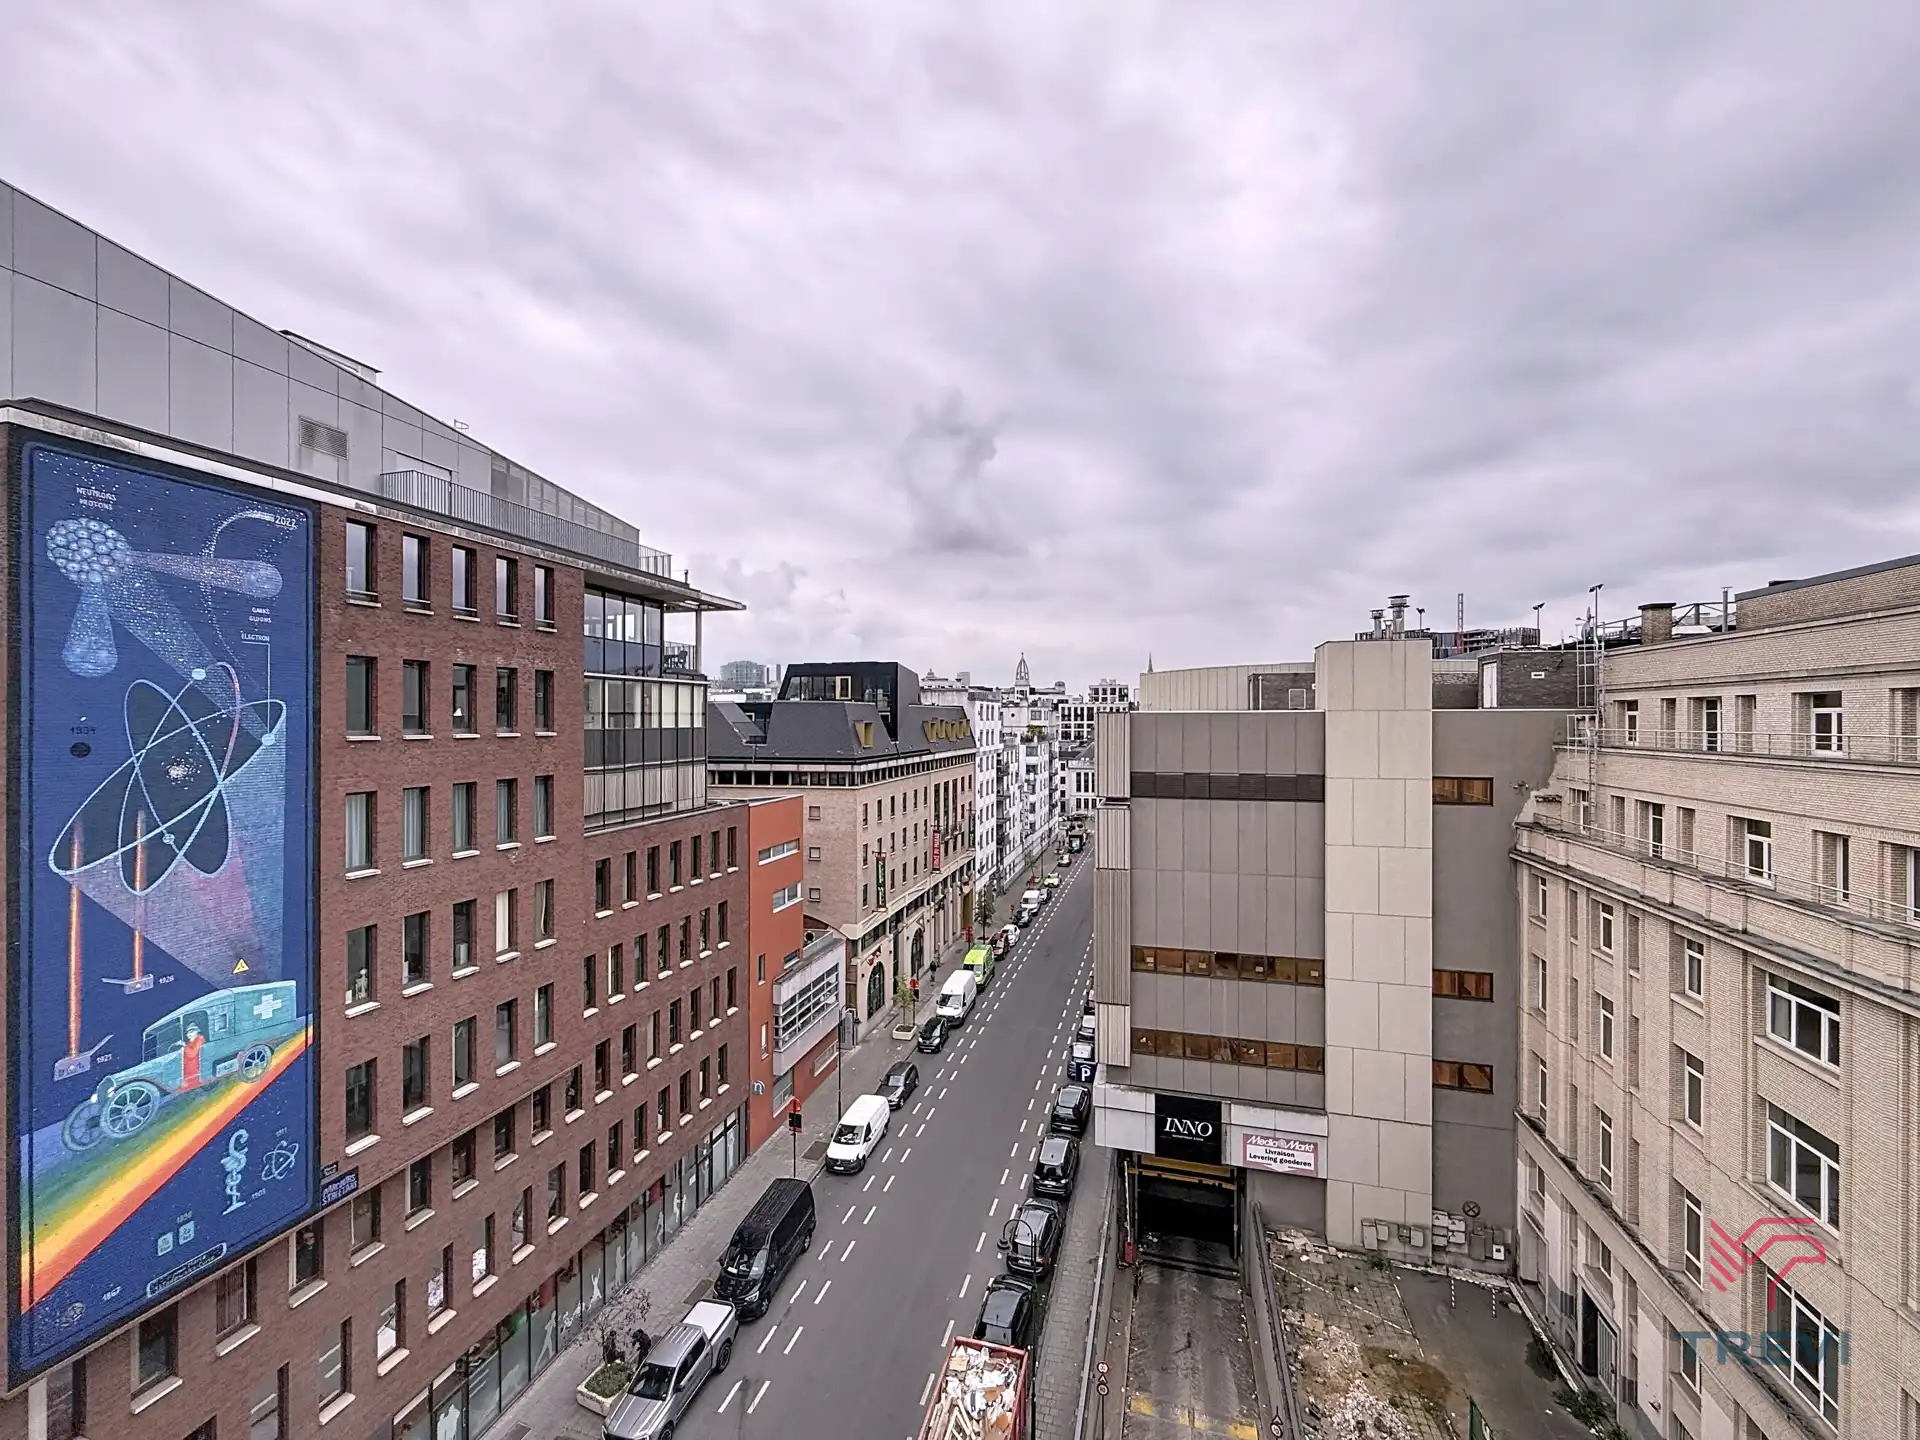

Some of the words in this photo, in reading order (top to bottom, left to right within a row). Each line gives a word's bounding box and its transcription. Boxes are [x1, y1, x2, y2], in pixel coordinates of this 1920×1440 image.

[241, 633, 270, 641] ELECTRON
[1081, 1067, 1091, 1081] P
[1164, 1117, 1212, 1137] INNO
[1246, 1135, 1278, 1148] Media
[1284, 1140, 1314, 1152] Markt
[1249, 1153, 1278, 1164] Levering
[1279, 1158, 1312, 1167] goederen
[1265, 1148, 1295, 1158] Livraison
